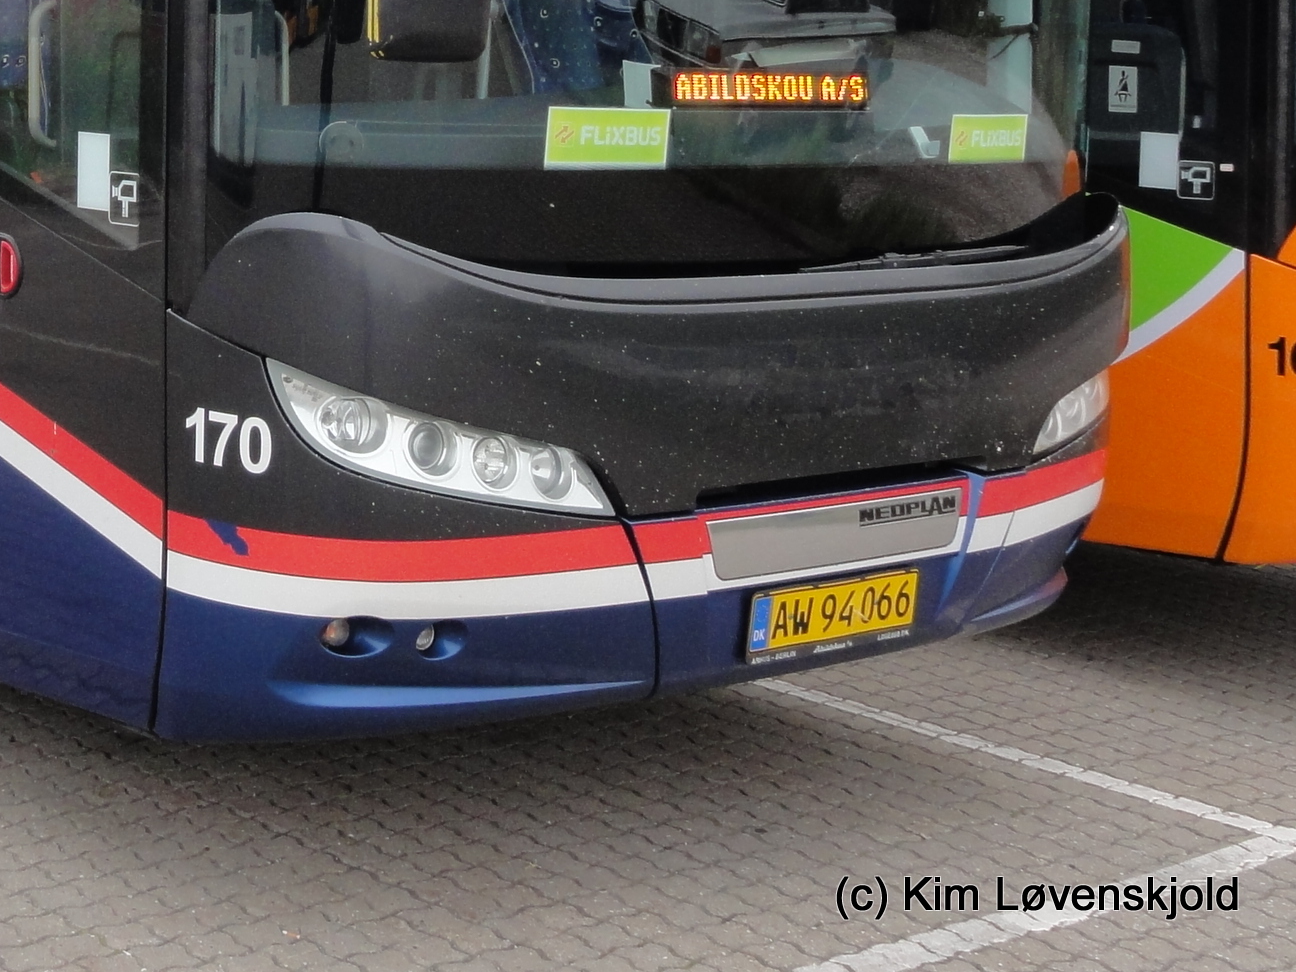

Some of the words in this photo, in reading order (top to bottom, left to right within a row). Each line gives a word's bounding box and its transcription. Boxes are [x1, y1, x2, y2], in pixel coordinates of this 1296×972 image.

[674, 73, 813, 102] ABILDSKOU
[821, 75, 864, 102] A/S
[1267, 336, 1296, 376] 1
[185, 407, 273, 474] 170
[859, 495, 956, 524] NEOPLAN
[771, 596, 814, 639] AW
[753, 630, 765, 642] DK
